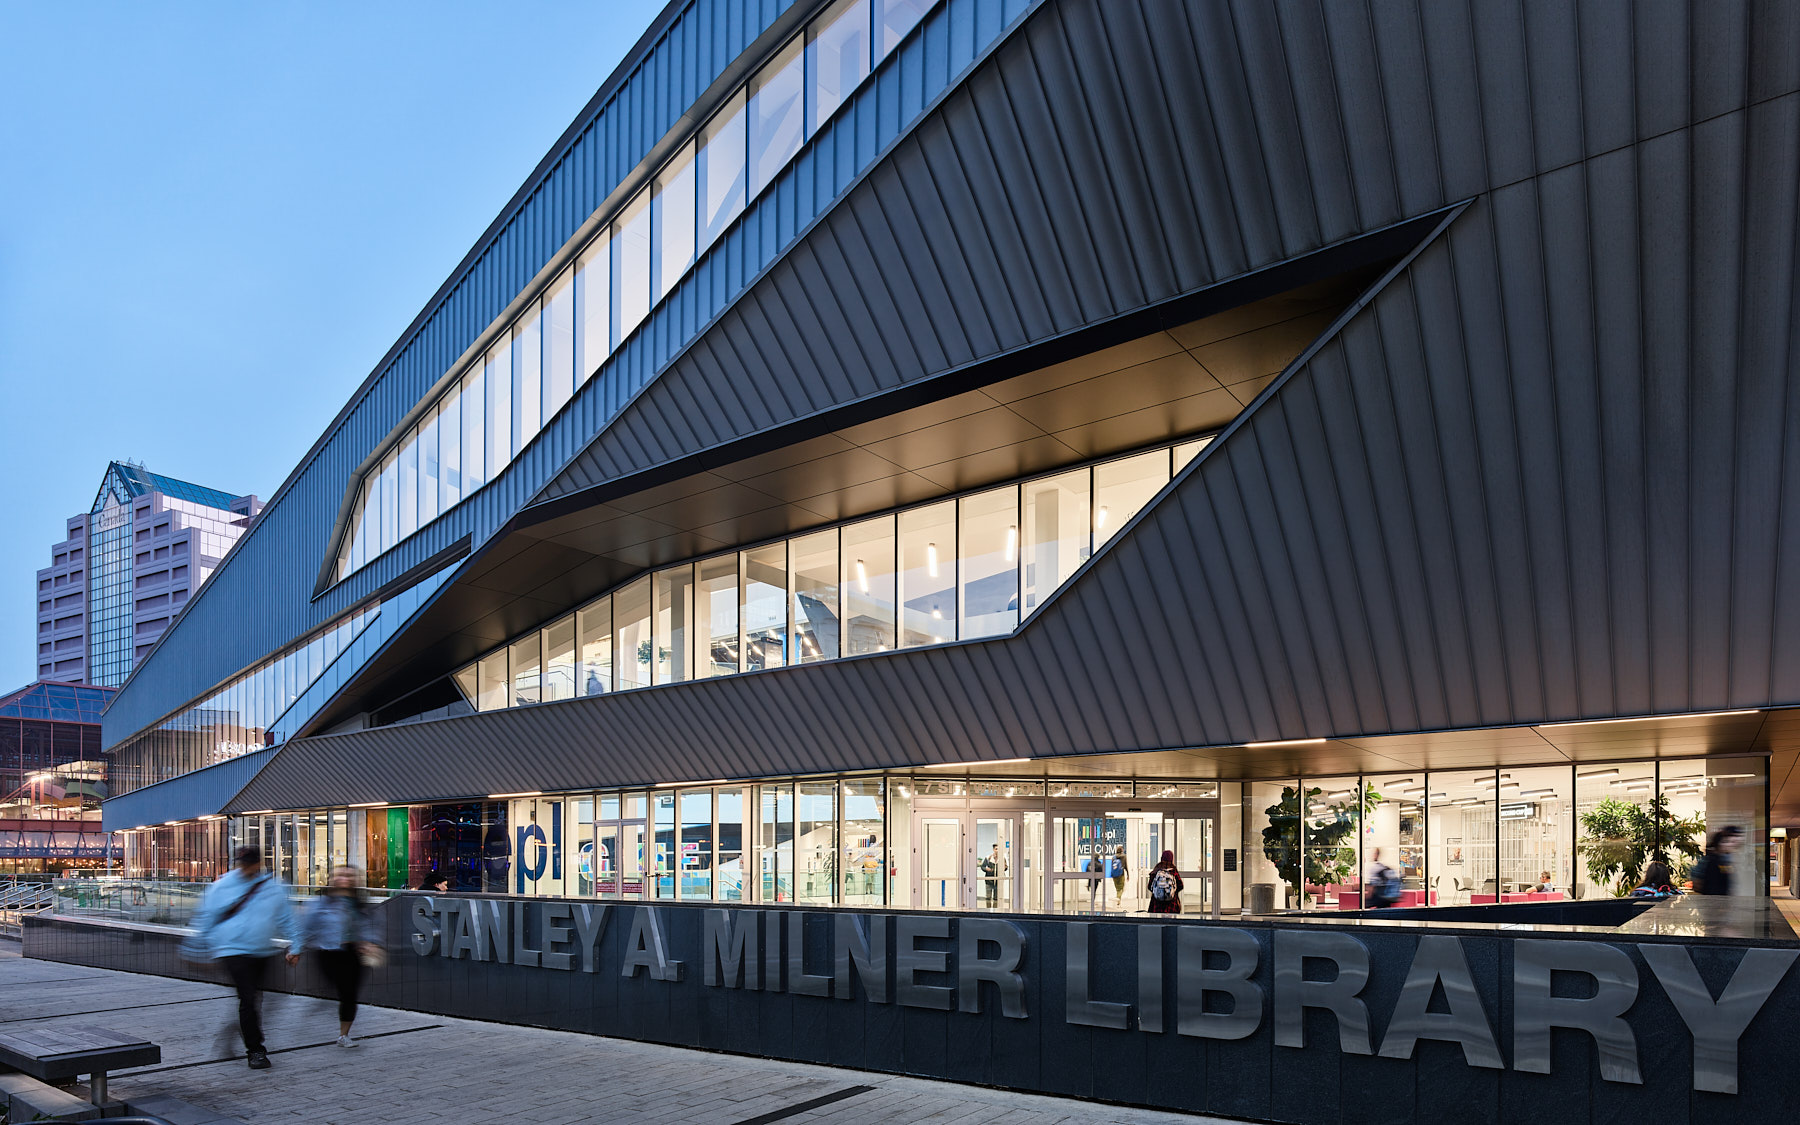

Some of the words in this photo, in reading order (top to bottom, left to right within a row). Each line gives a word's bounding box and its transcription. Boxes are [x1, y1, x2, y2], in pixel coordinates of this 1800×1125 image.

[411, 895, 611, 974] STANLEY
[621, 906, 684, 982] A.
[704, 908, 1029, 1020] MILNER
[1066, 922, 1800, 1094] LIBRARY
